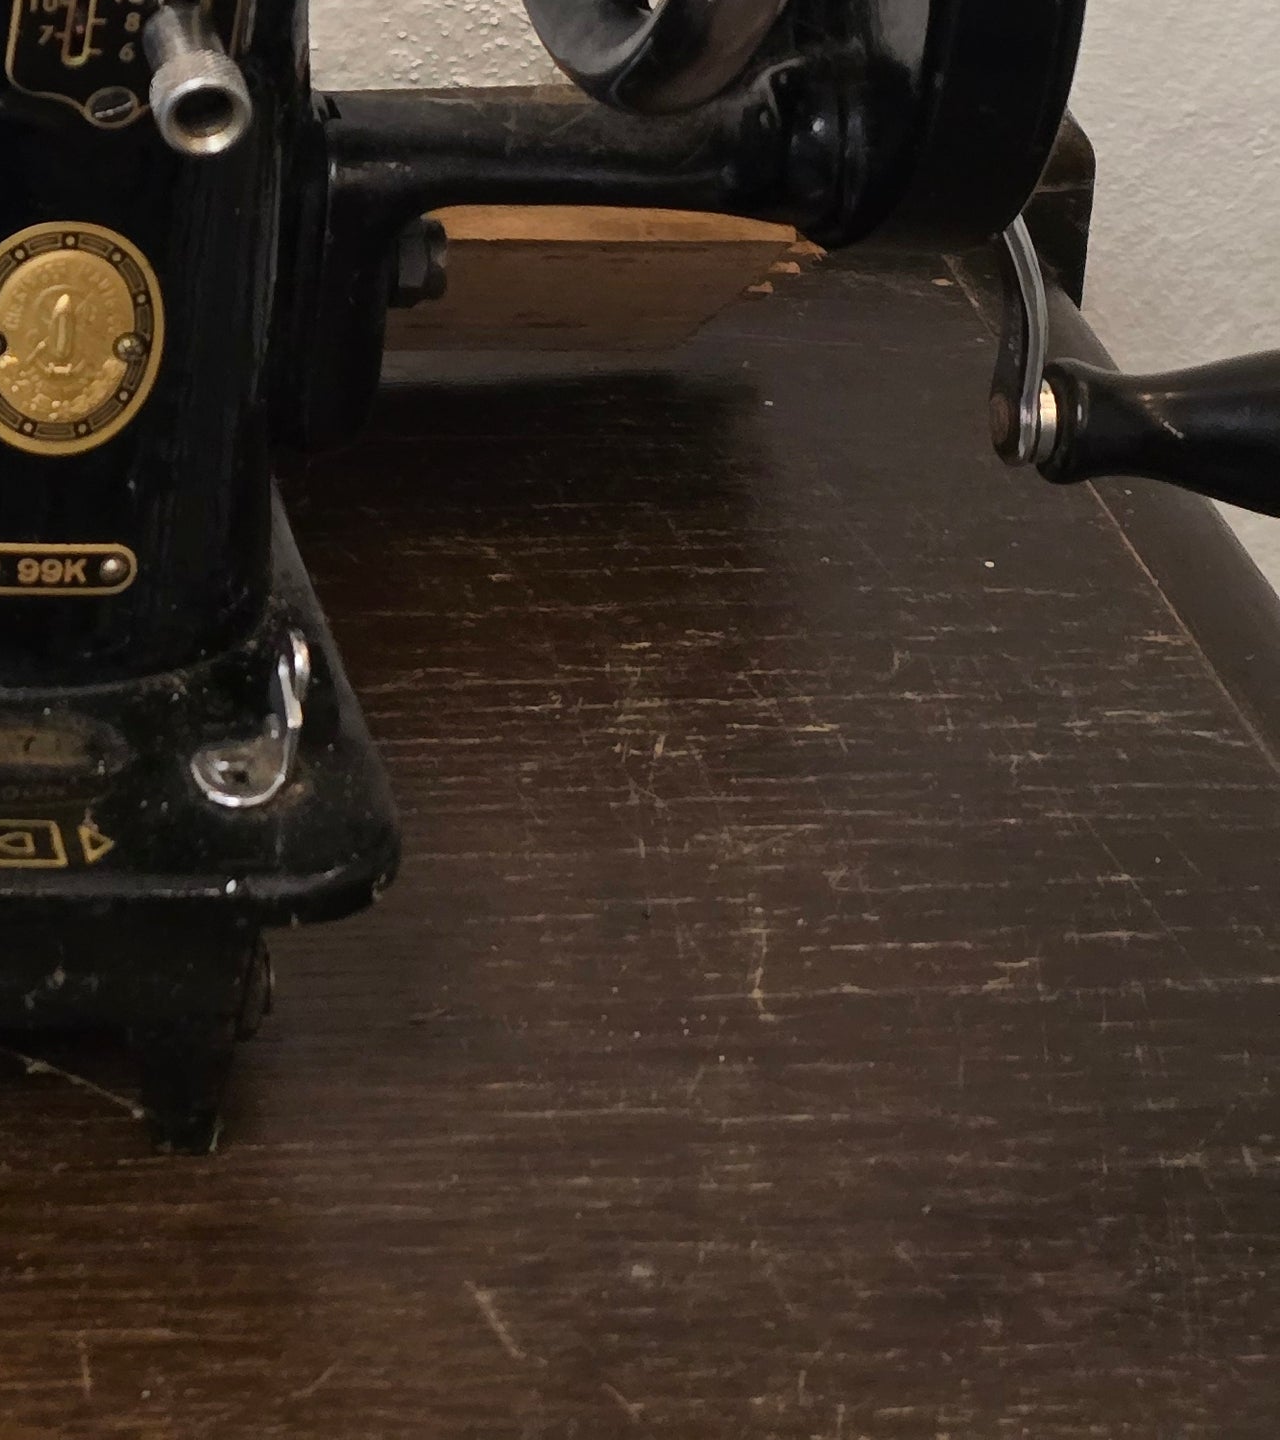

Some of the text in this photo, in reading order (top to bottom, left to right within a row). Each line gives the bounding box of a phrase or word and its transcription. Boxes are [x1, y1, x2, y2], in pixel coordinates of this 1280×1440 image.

[124, 12, 142, 33] 8
[38, 25, 55, 47] 7
[119, 41, 137, 62] 6
[17, 558, 88, 585] 99K
